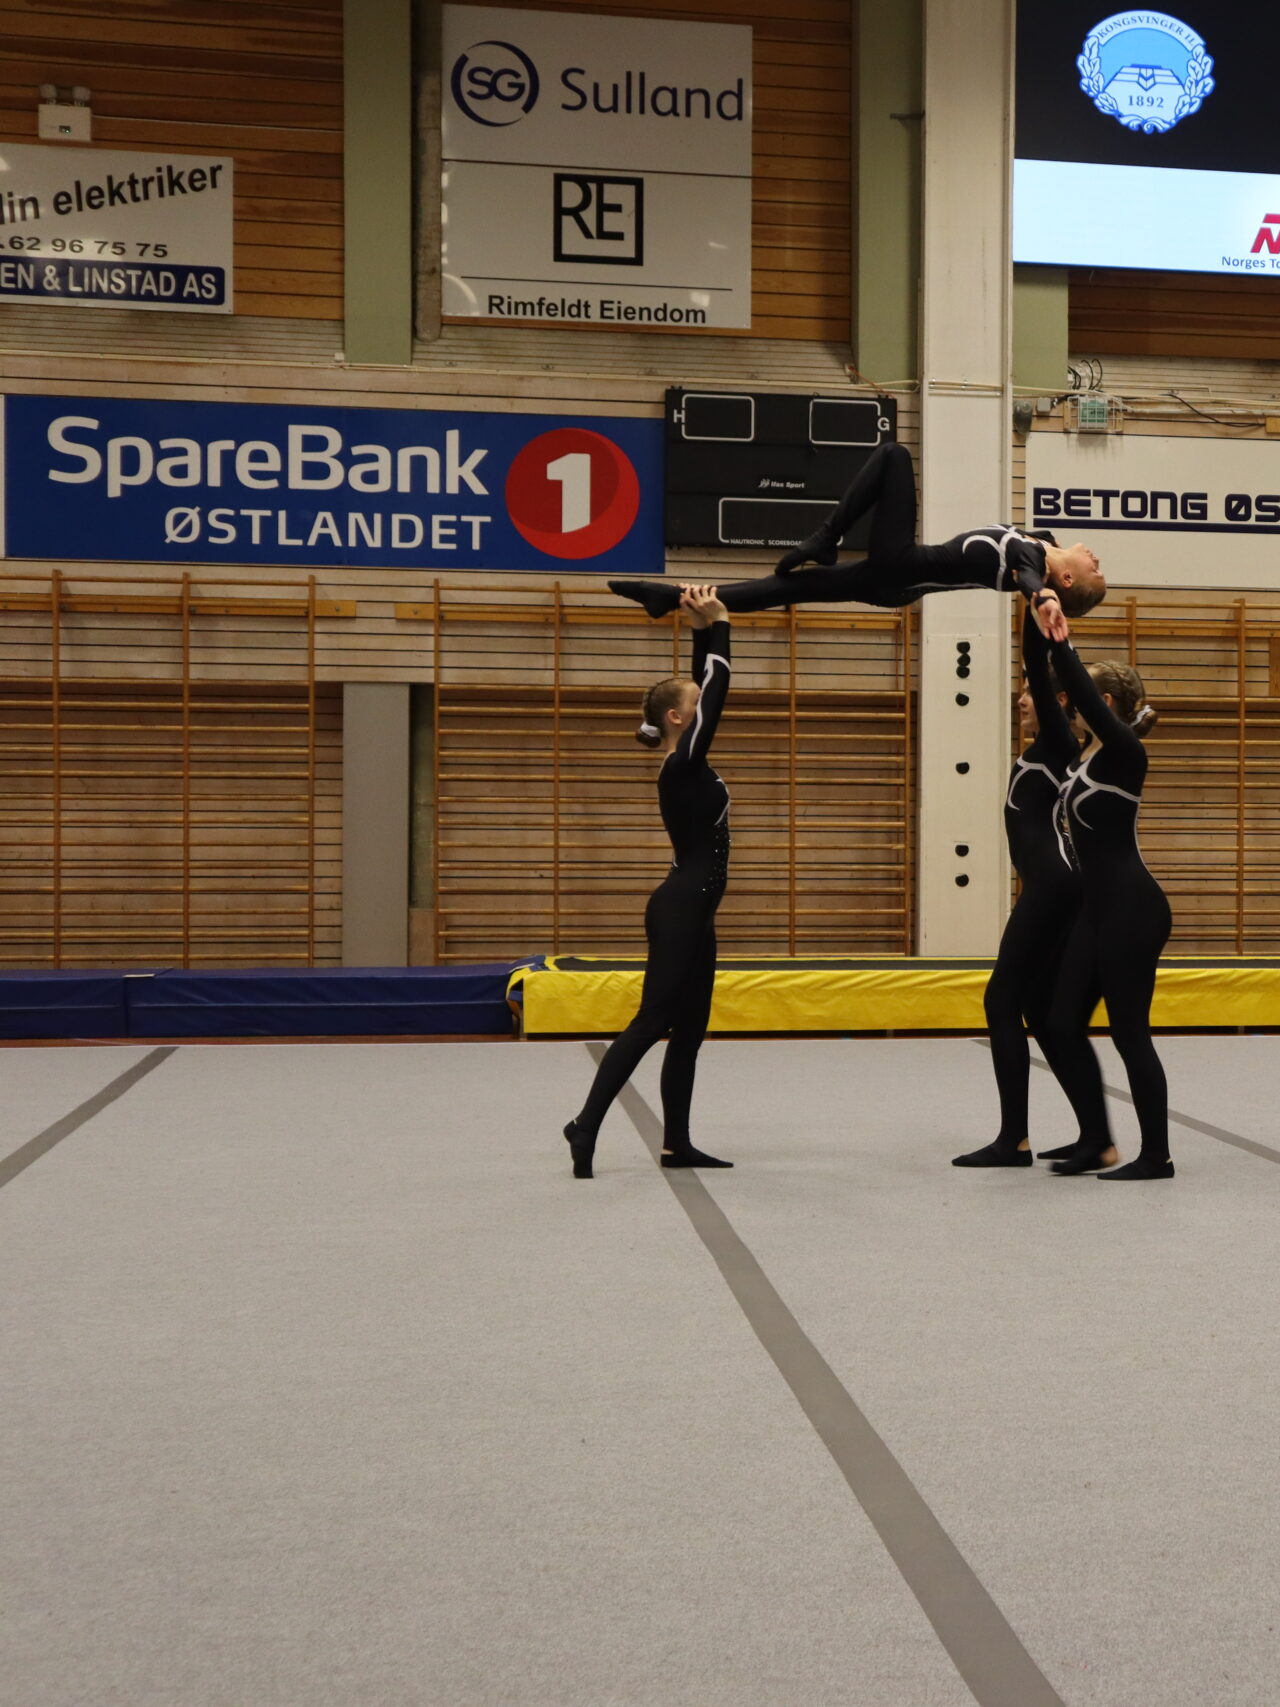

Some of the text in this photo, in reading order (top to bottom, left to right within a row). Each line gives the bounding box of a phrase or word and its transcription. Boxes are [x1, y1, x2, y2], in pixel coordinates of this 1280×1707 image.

[1098, 15, 1197, 47] KONGSVINGER IL
[561, 67, 744, 121] Sulland
[1128, 95, 1164, 108] 1892
[53, 164, 223, 215] elektriker
[51, 238, 84, 253] 96
[94, 240, 126, 255] 75
[136, 242, 168, 258] 75
[1221, 256, 1266, 269] Norges
[43, 264, 61, 291] &
[69, 265, 176, 297] LINSTAD
[183, 272, 217, 299] AS
[488, 294, 706, 323] Rimfeldt Eiendom
[673, 408, 685, 424] H
[877, 416, 890, 432] G
[47, 416, 591, 533] SpareBank 1
[1033, 487, 1208, 520] BETONG
[163, 506, 492, 550] ØSTLANDET
